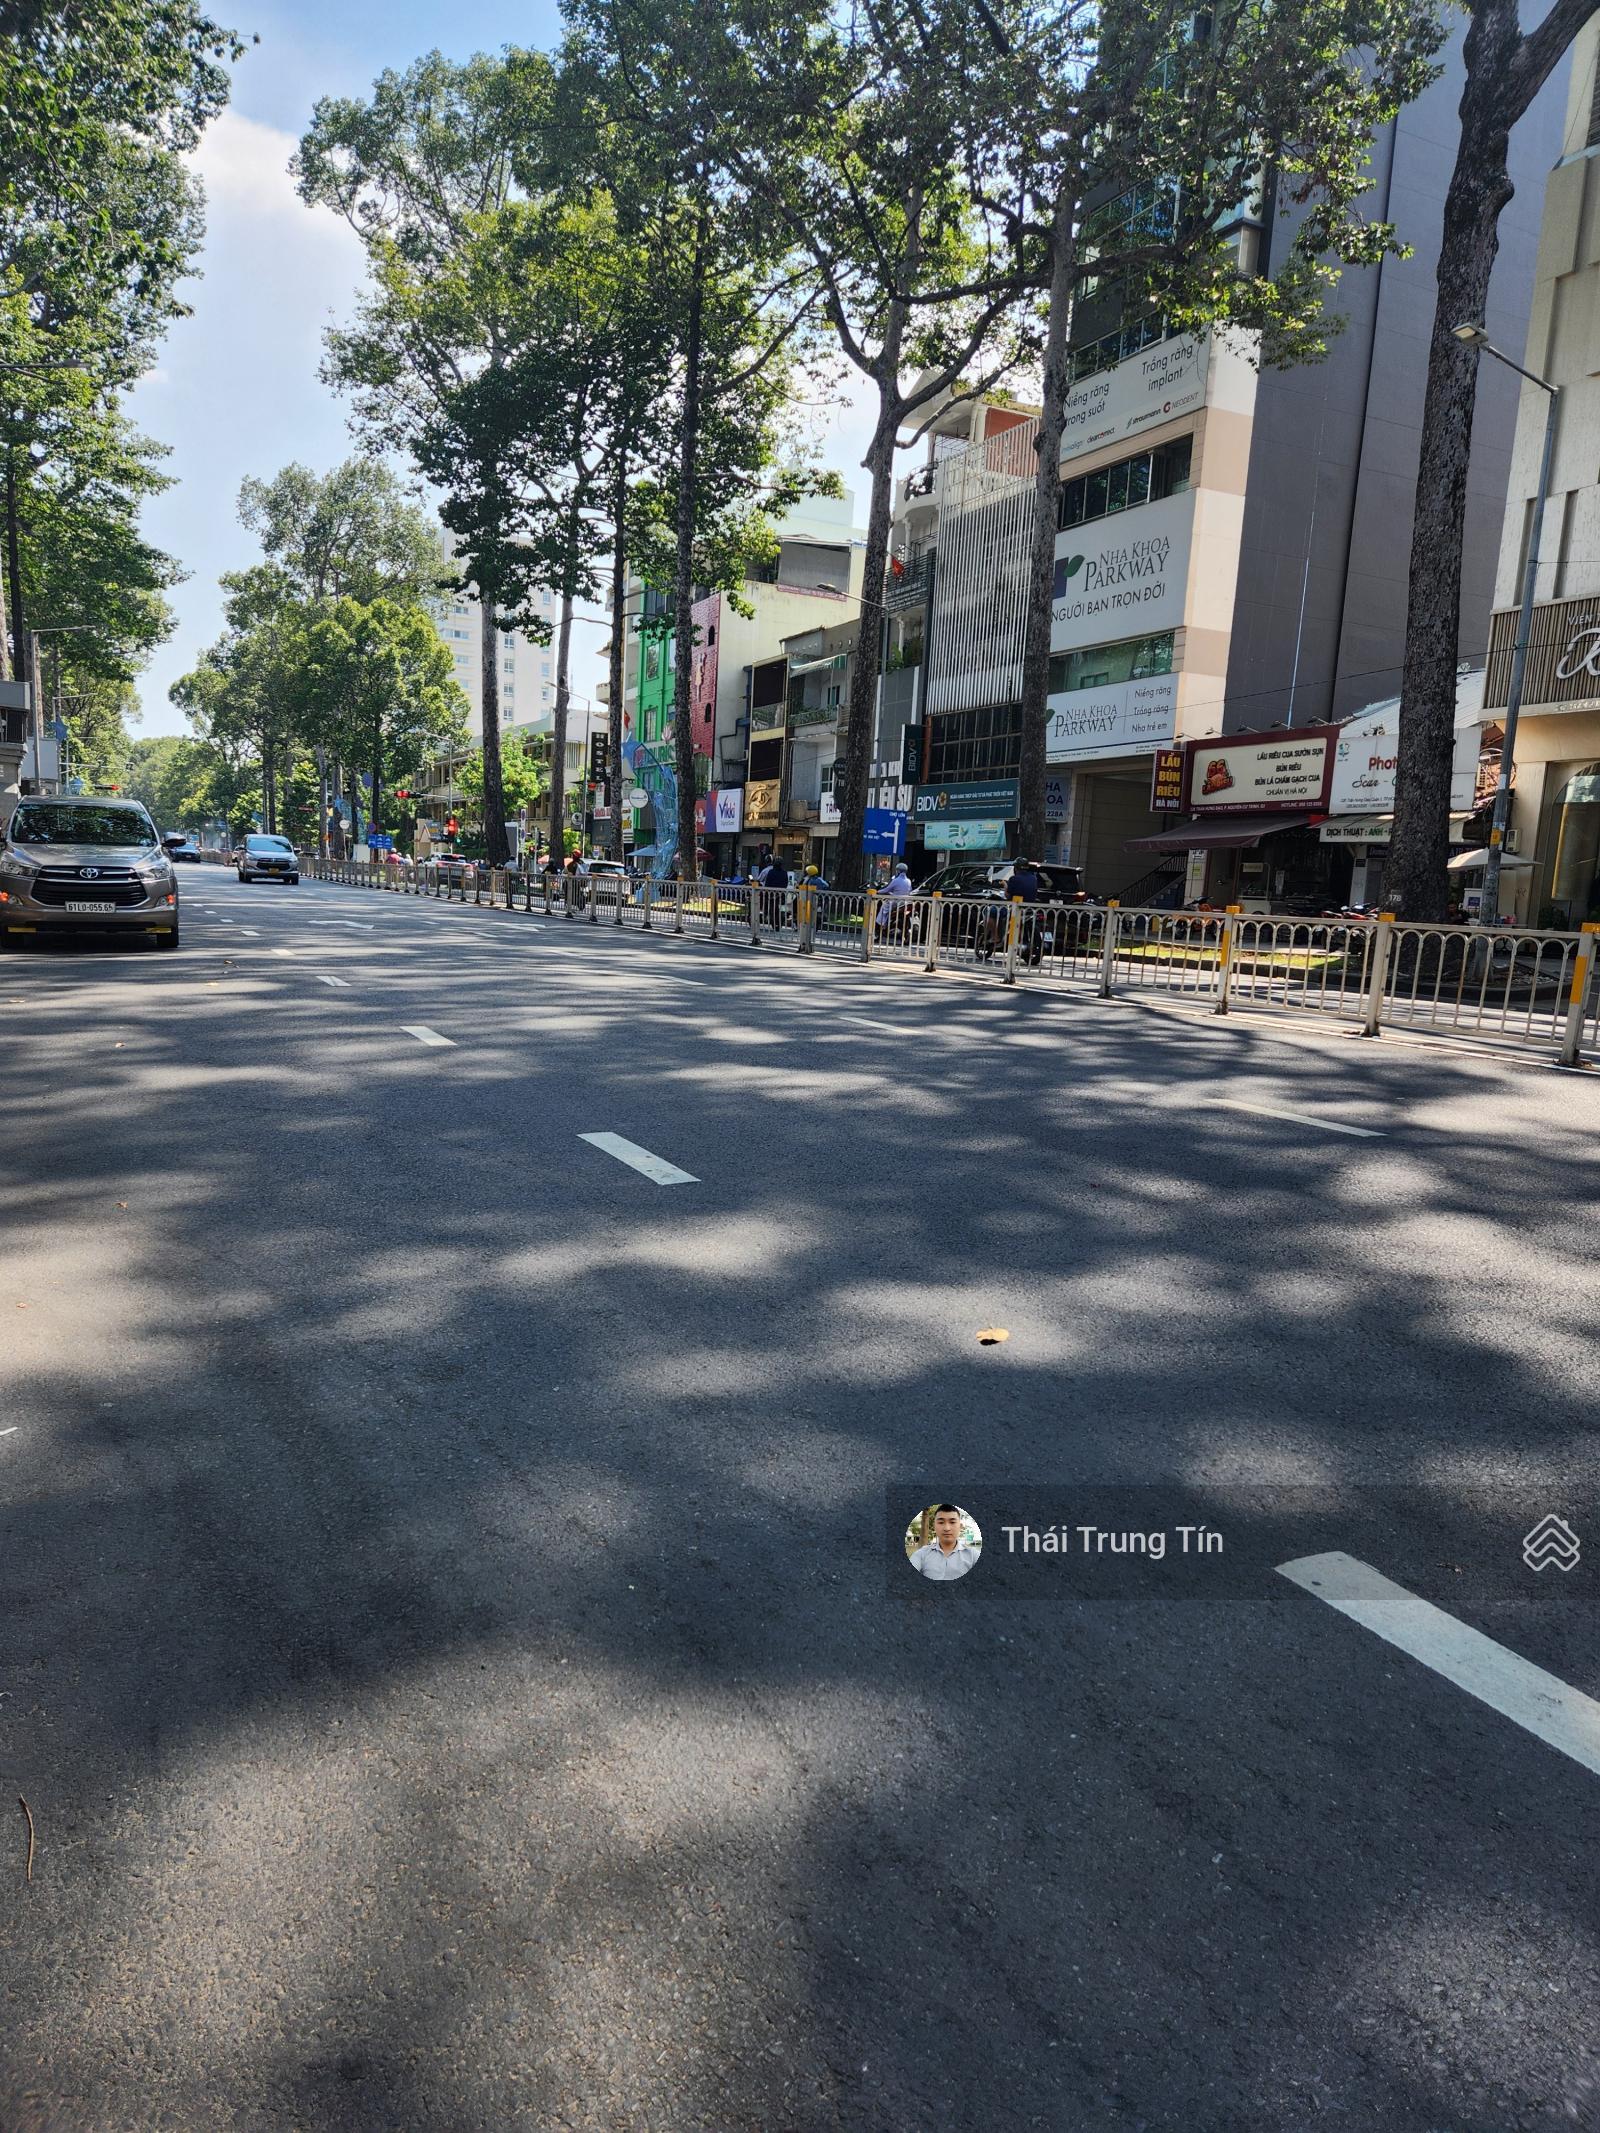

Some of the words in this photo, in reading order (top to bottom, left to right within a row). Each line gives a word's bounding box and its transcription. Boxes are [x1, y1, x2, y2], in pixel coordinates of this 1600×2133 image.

[1142, 356, 1168, 375] Trồng
[1170, 345, 1193, 362] răng
[1148, 367, 1184, 391] implant
[1064, 390, 1088, 410] Niềng
[1089, 383, 1110, 401] răng
[1088, 400, 1106, 417] suốt
[1100, 548, 1128, 568] NHA
[1132, 536, 1170, 559] KHOA
[1087, 597, 1109, 616] BẠN
[1111, 589, 1141, 609] TRỌN
[1143, 581, 1166, 602] ĐỜI
[1067, 708, 1087, 720] NHA
[1090, 704, 1118, 718] KHOA
[1132, 723, 1146, 733] Nha
[595, 733, 605, 780] HOSTEL
[908, 749, 917, 772] BIDV
[1158, 769, 1180, 782] BÚN
[1308, 774, 1320, 782] CUA
[1156, 784, 1180, 797] RIÊU
[719, 795, 736, 818] Vikki
[917, 795, 939, 812] BIDV
[1326, 829, 1341, 838] DỊCH
